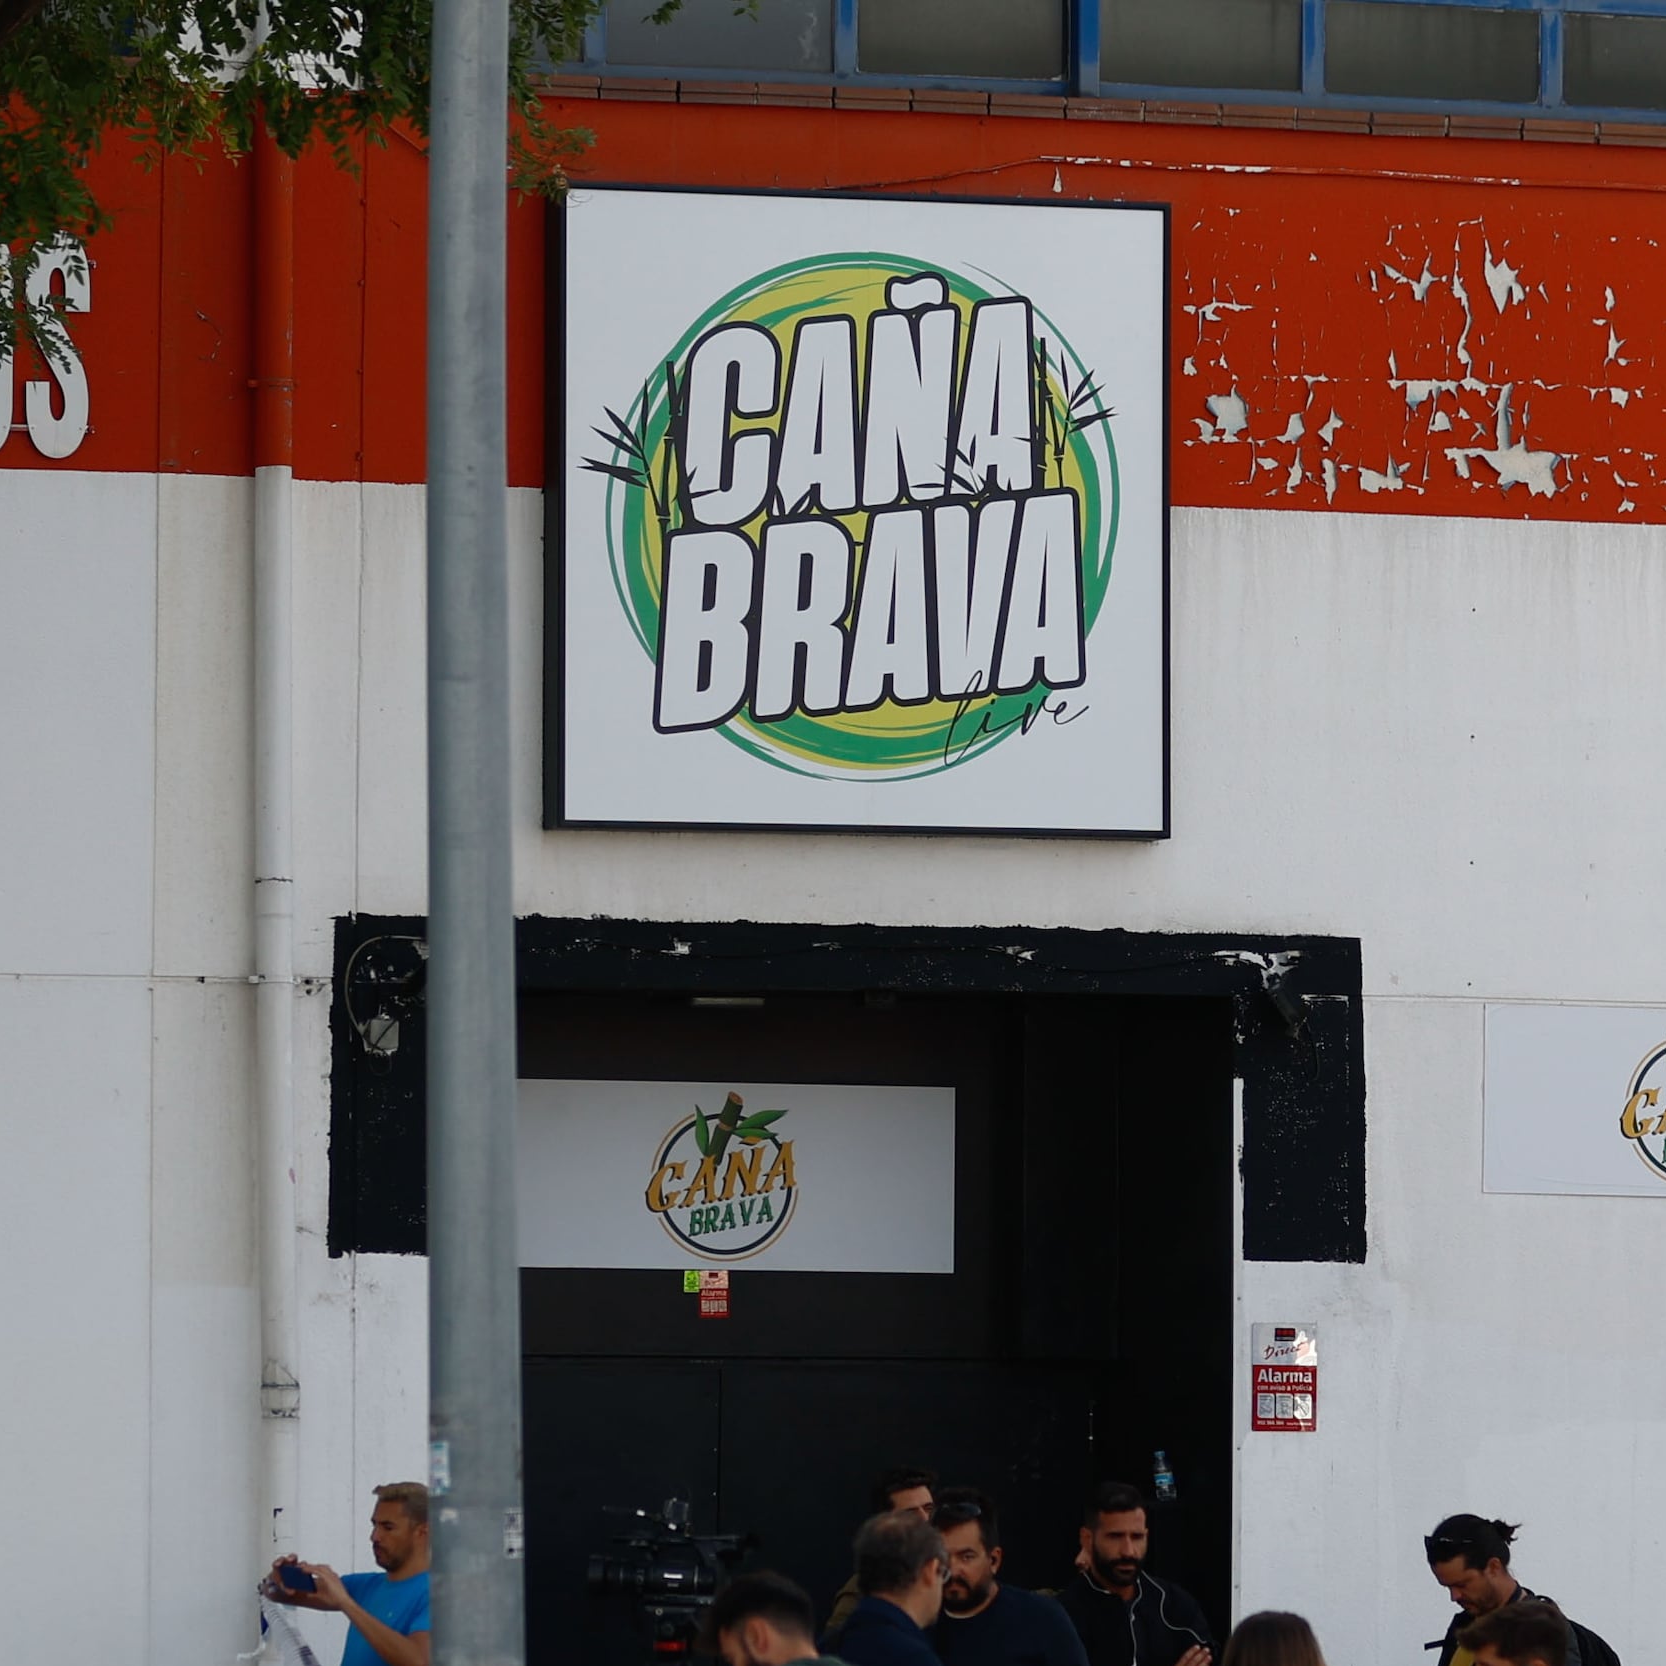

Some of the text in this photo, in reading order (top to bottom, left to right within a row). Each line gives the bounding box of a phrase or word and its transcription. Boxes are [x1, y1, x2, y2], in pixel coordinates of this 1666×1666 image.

[681, 271, 1034, 528] CAÑA
[652, 487, 1086, 735] BRAVA
[645, 1136, 797, 1213] CAÑA
[688, 1195, 774, 1238] BRAVA
[1257, 1368, 1313, 1384] Alarma
